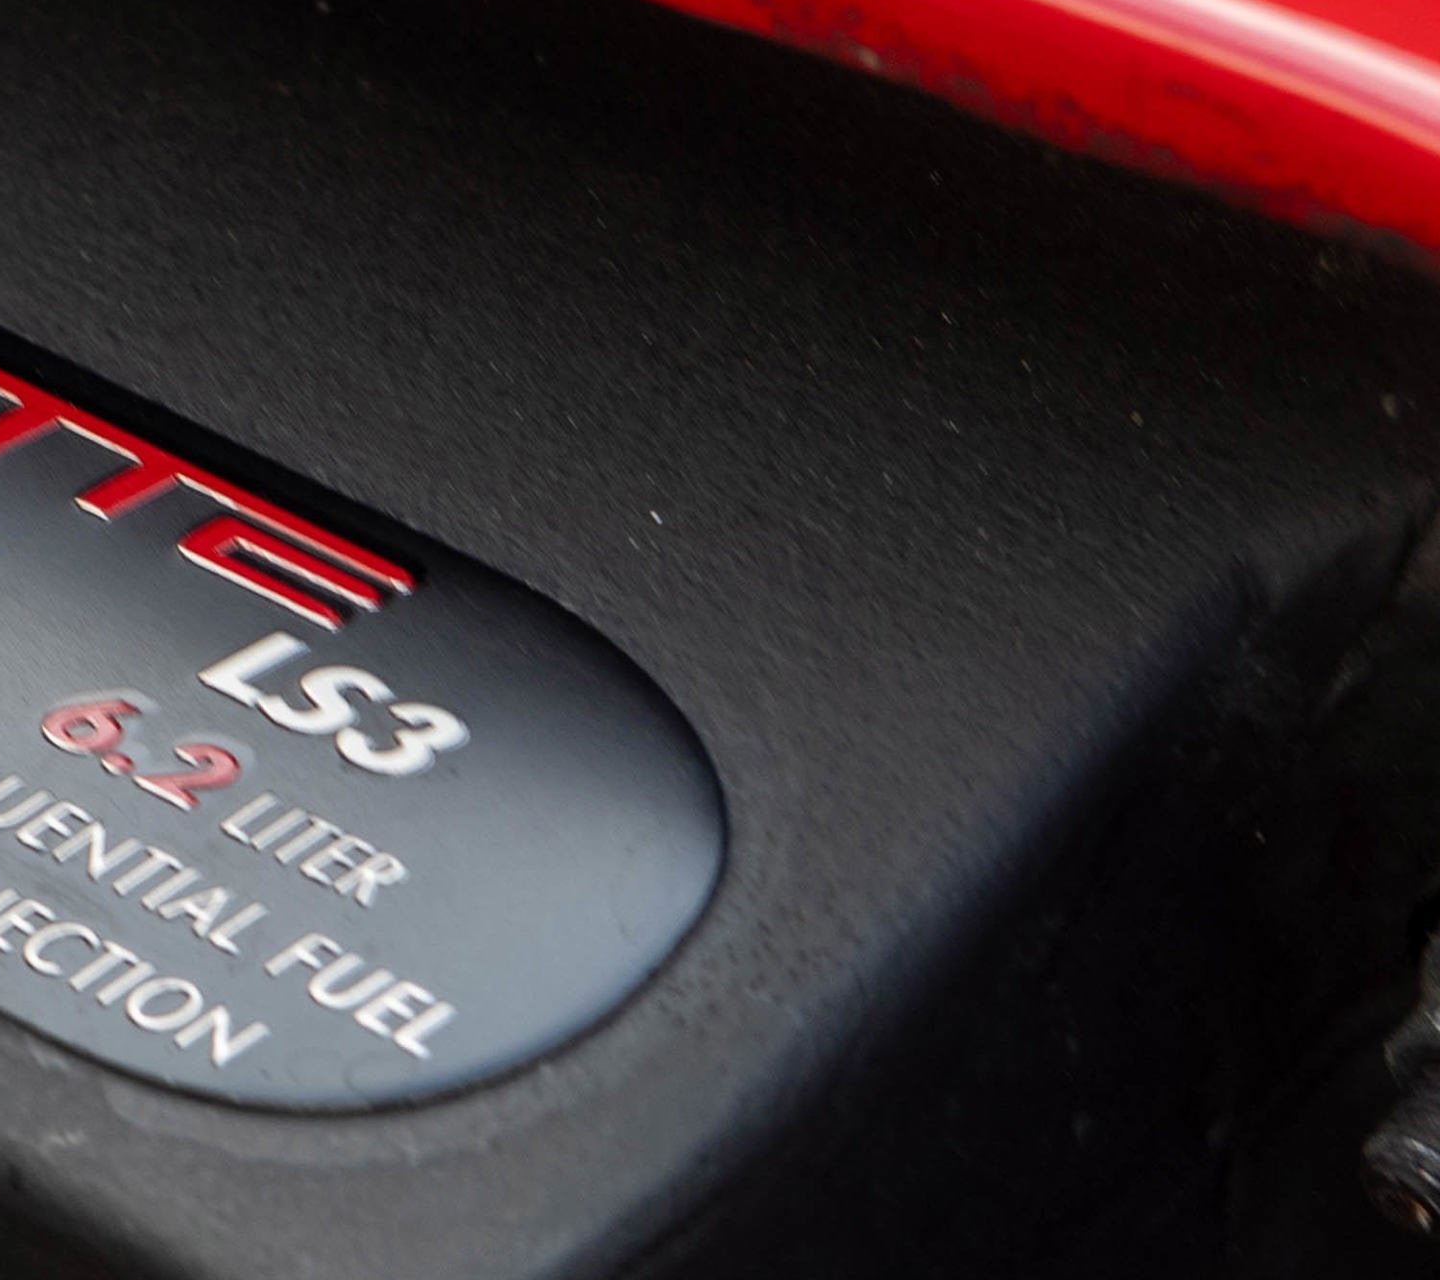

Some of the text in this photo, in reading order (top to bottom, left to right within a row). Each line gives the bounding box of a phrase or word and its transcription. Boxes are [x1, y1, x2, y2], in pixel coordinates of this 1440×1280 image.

[198, 631, 471, 775] LS3
[41, 694, 408, 908] 6.2 LITER
[264, 931, 458, 1060] FUEL
